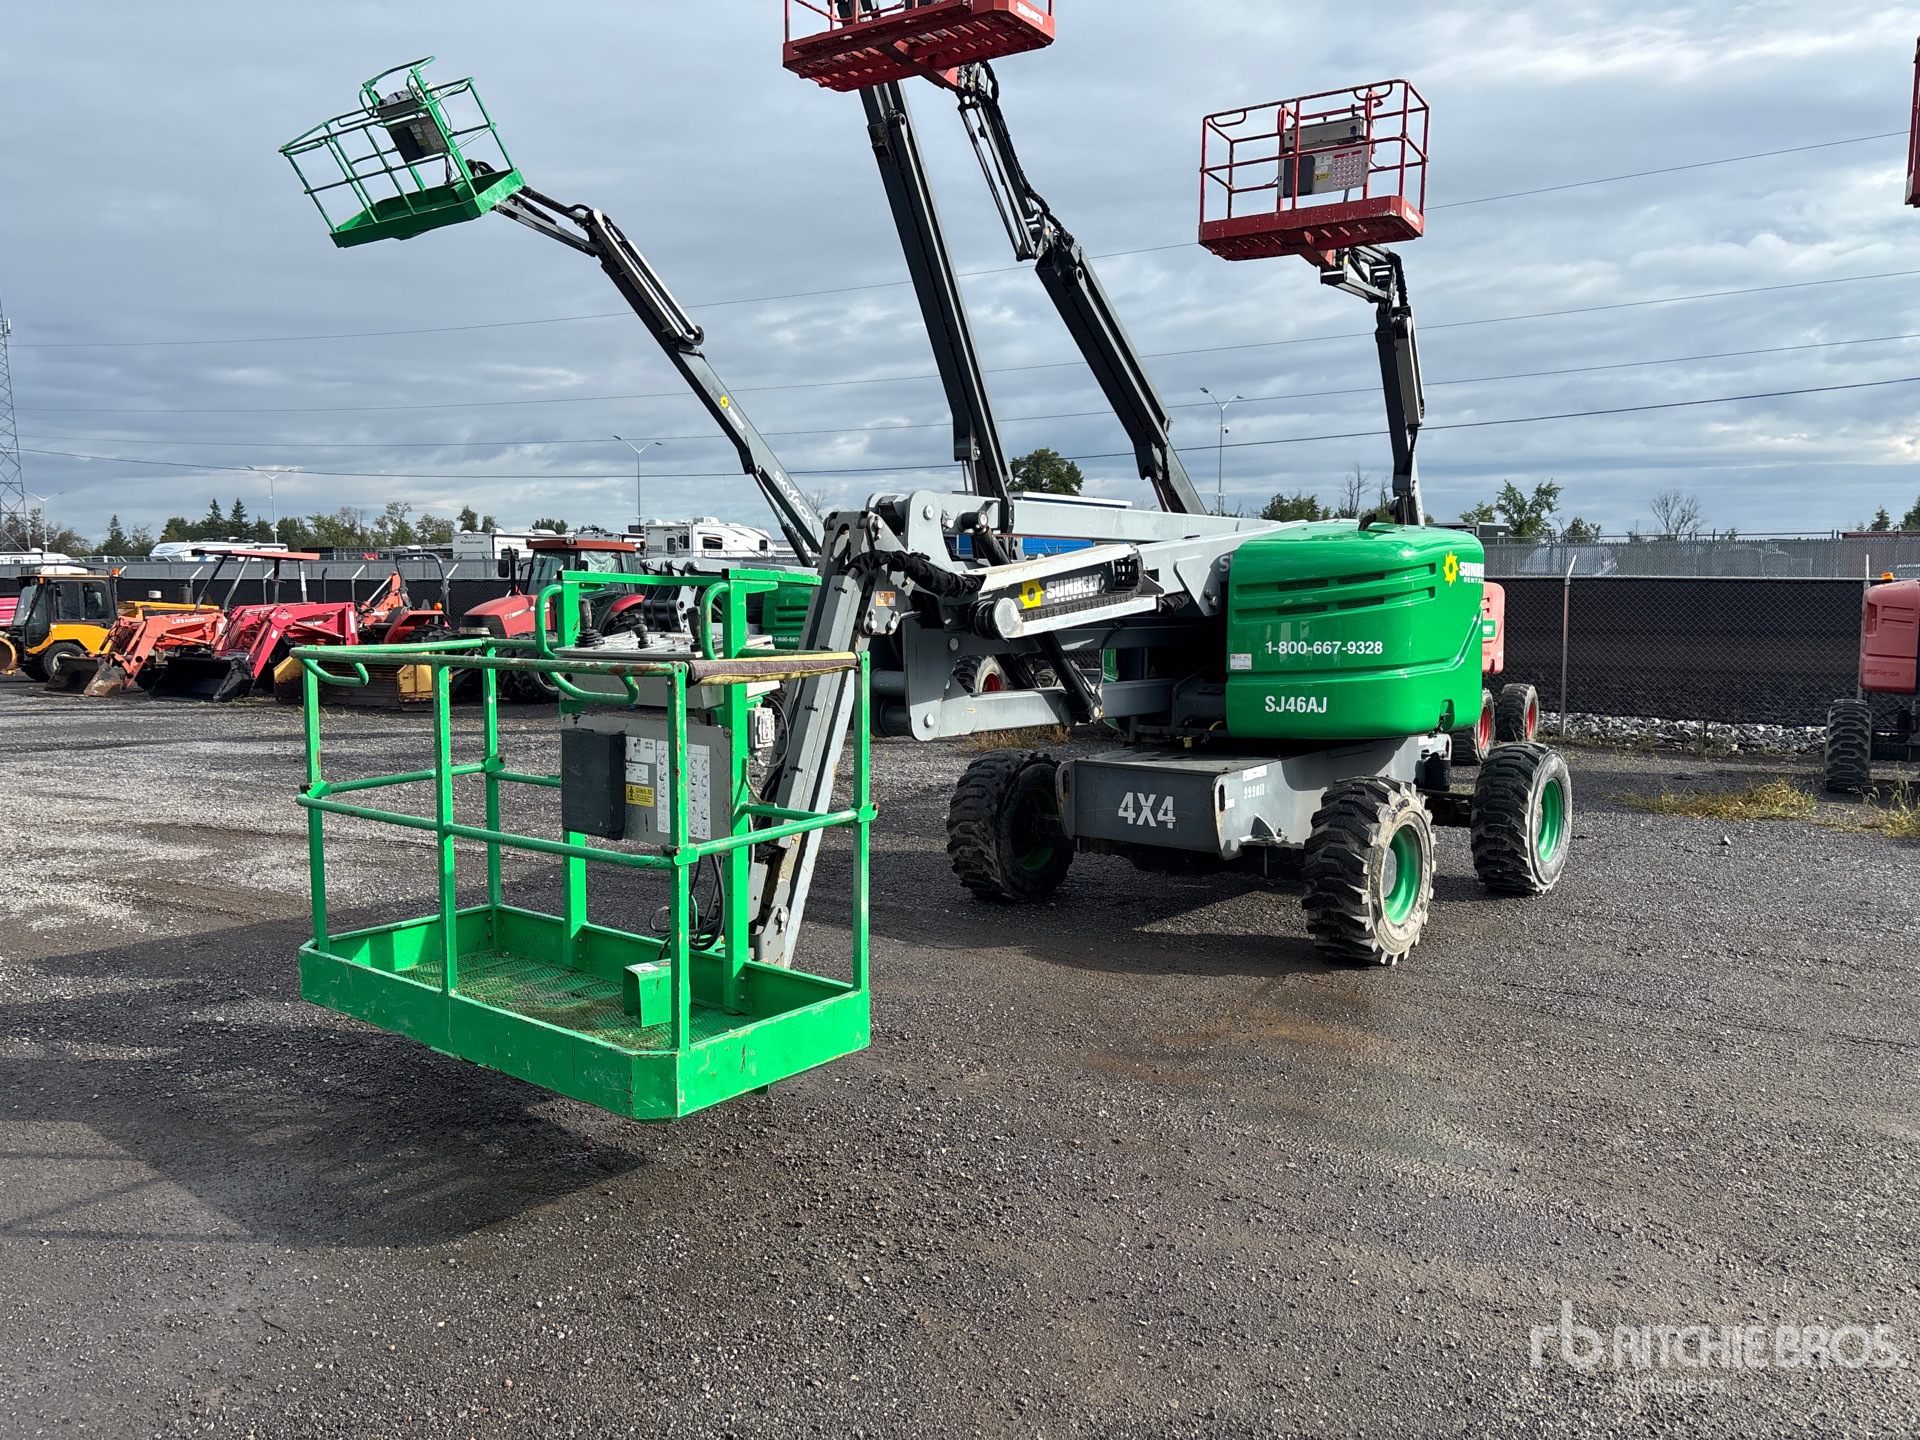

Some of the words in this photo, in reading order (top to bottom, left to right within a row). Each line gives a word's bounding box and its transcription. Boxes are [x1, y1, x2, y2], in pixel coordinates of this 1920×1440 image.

[774, 470, 813, 526] SKYJACK
[1046, 574, 1101, 599] SUNBELT
[1265, 641, 1383, 655] 1-800-667-9328
[1264, 695, 1328, 713] SJ46AJ
[1117, 791, 1176, 829] 4X4
